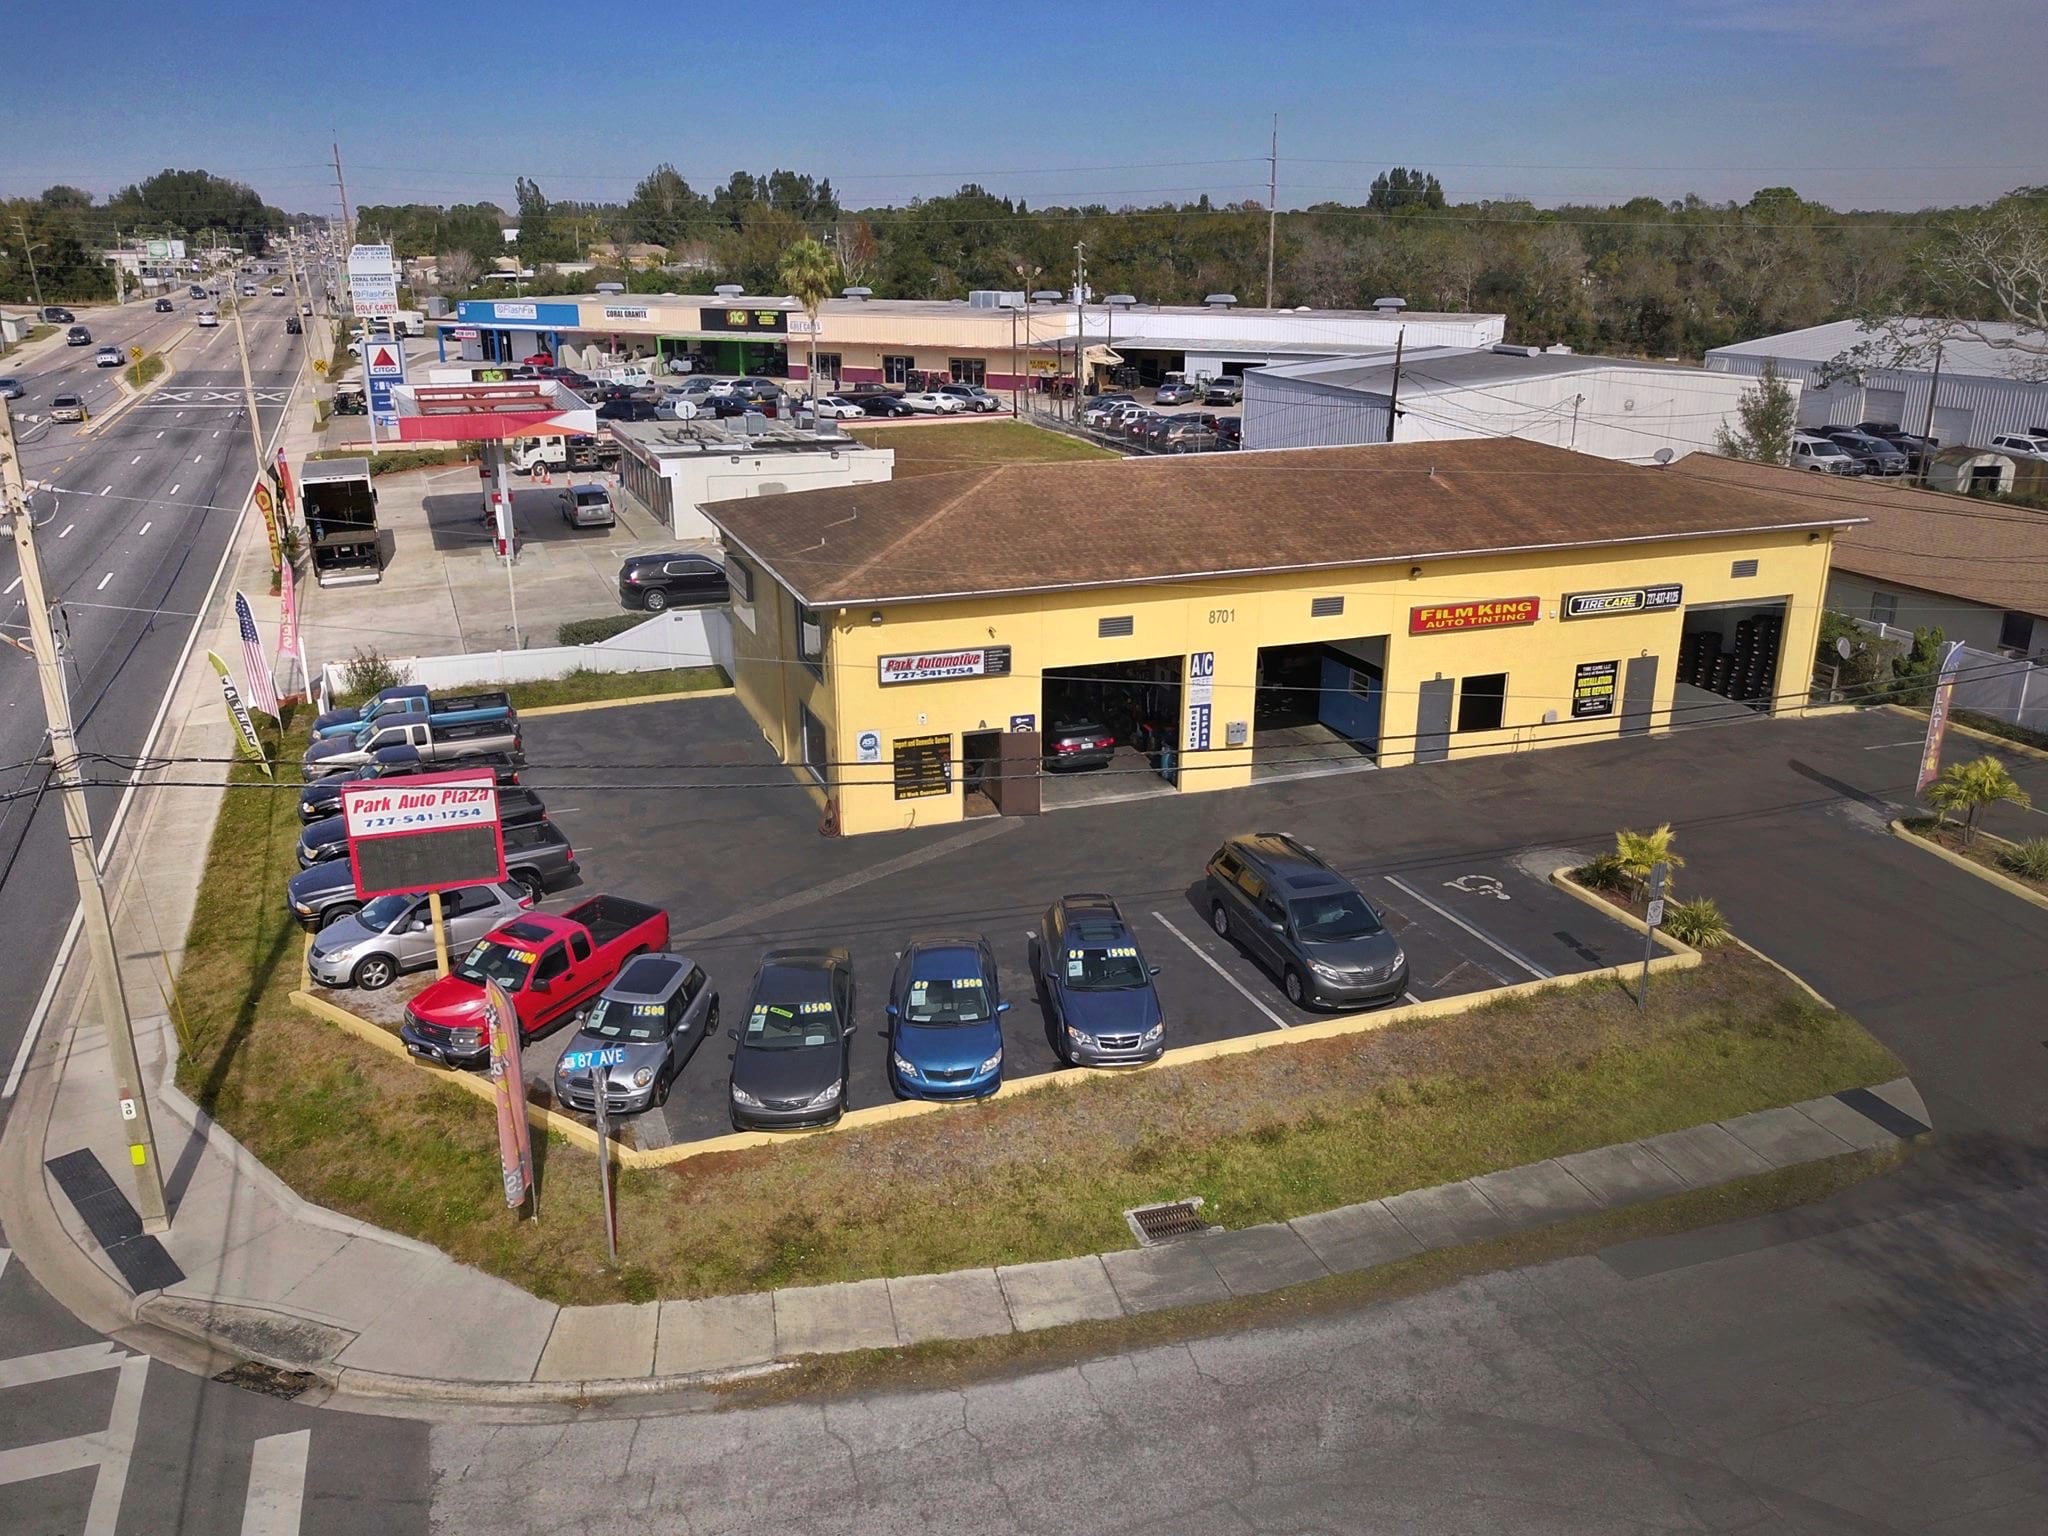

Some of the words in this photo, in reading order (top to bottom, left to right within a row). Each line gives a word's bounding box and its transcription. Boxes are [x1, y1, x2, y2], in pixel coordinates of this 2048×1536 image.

[606, 310, 623, 318] CORAL
[624, 310, 647, 319] GRANITE
[1578, 594, 1637, 610] TIRECARE
[1209, 608, 1235, 624] 8701
[1420, 607, 1473, 621] FILM
[1477, 602, 1532, 616] KING
[1425, 618, 1464, 629] AUTO
[1470, 613, 1526, 625] TINTING
[1640, 649, 1648, 658] C
[885, 659, 914, 673] Park
[916, 653, 982, 669] Automotive
[1191, 653, 1213, 676] A/C
[893, 667, 974, 680] 727-541-1754
[1435, 671, 1442, 679] B
[1580, 687, 1591, 697] TIRE
[978, 720, 987, 729] A
[1190, 709, 1198, 748] SERVICE
[1200, 708, 1209, 747] REPAIR
[353, 797, 390, 814] Park
[398, 794, 436, 809] Auto
[441, 788, 488, 804] Plaza
[364, 808, 481, 827] 727-541-1754
[1069, 949, 1084, 959] 09
[914, 981, 928, 990] 09
[597, 999, 610, 1010] 11
[754, 1004, 768, 1014] 06
[578, 1053, 592, 1067] 87
[600, 1049, 624, 1064] AVE
